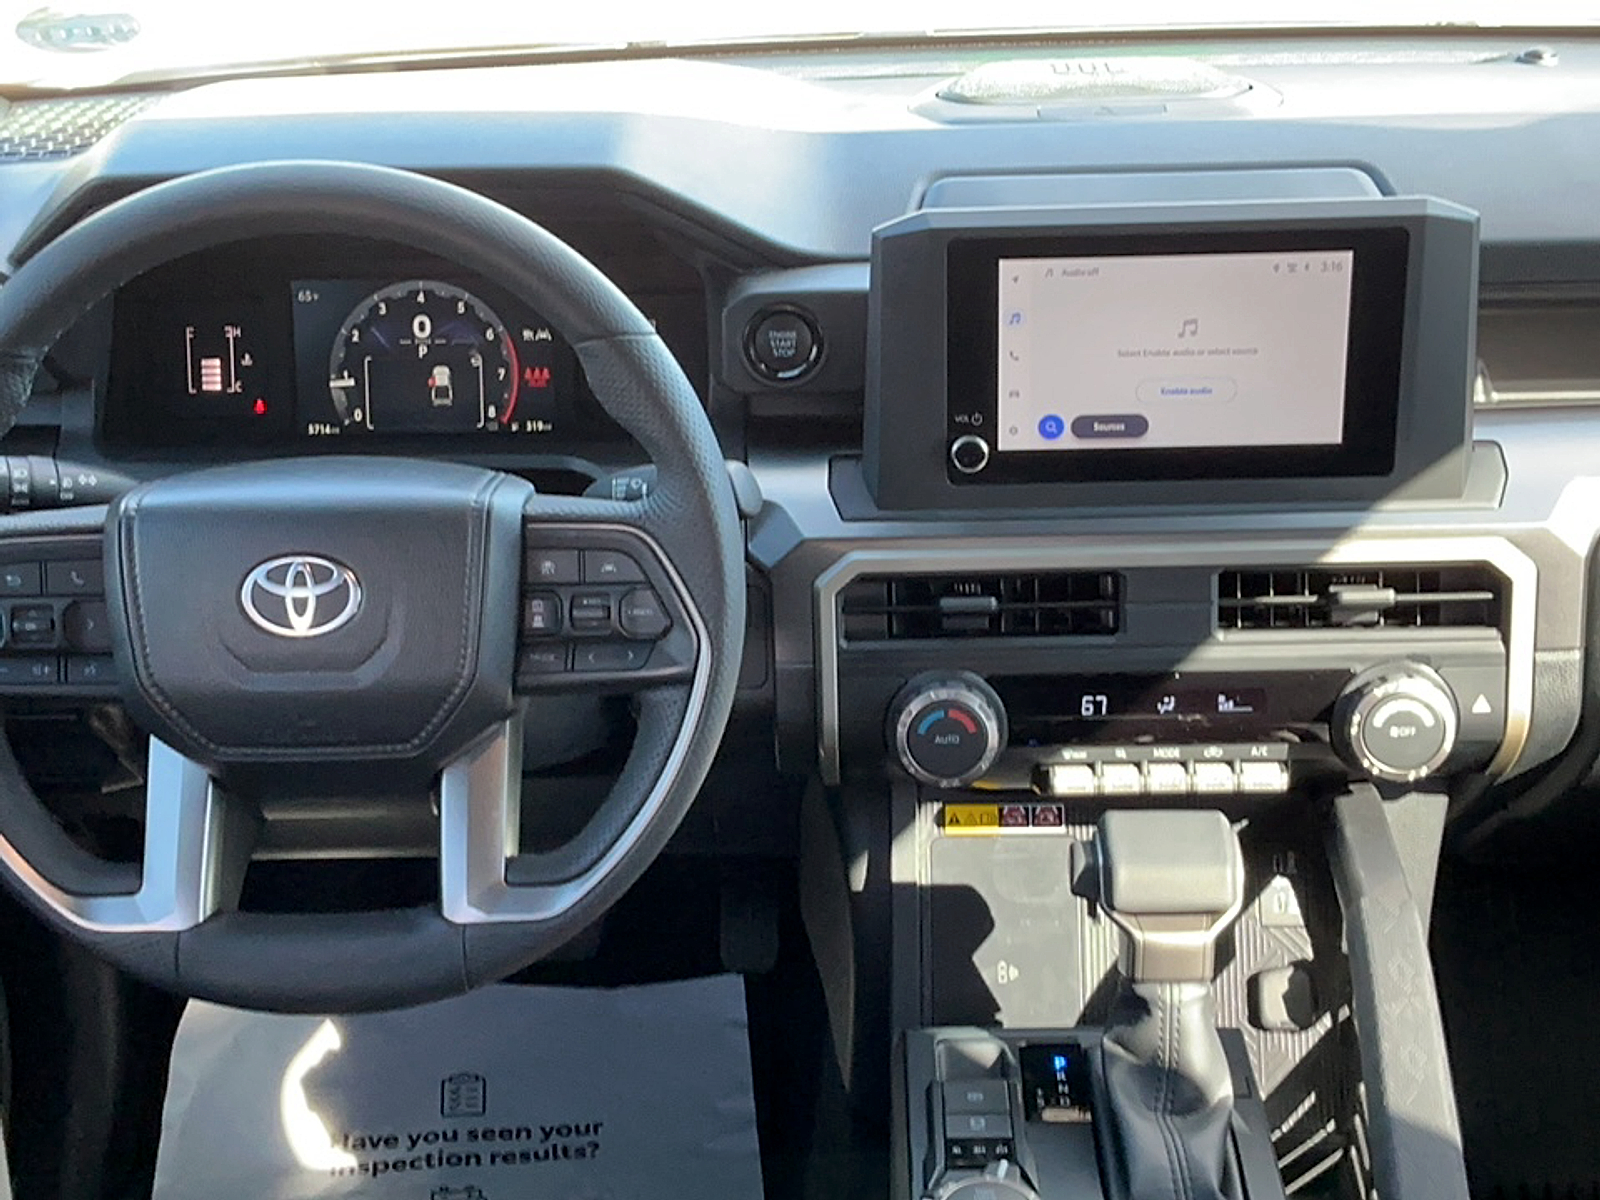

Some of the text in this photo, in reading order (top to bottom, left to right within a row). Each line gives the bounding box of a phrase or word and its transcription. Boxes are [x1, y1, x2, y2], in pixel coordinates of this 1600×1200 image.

[1320, 260, 1343, 273] 3:16
[416, 290, 425, 303] 4
[378, 301, 387, 315] 3
[456, 301, 465, 314] 5
[412, 313, 432, 339] 0
[351, 328, 360, 343] 2
[485, 327, 495, 341] 6
[417, 345, 428, 359] P
[497, 366, 506, 381] 7
[1160, 386, 1213, 396] Enable audio
[353, 407, 363, 422] 0
[1081, 694, 1108, 717] 67
[934, 734, 961, 745] AUTO
[407, 1128, 459, 1152] you
[467, 1126, 533, 1143] seen
[540, 1121, 604, 1144] your
[490, 1141, 600, 1167] results?
